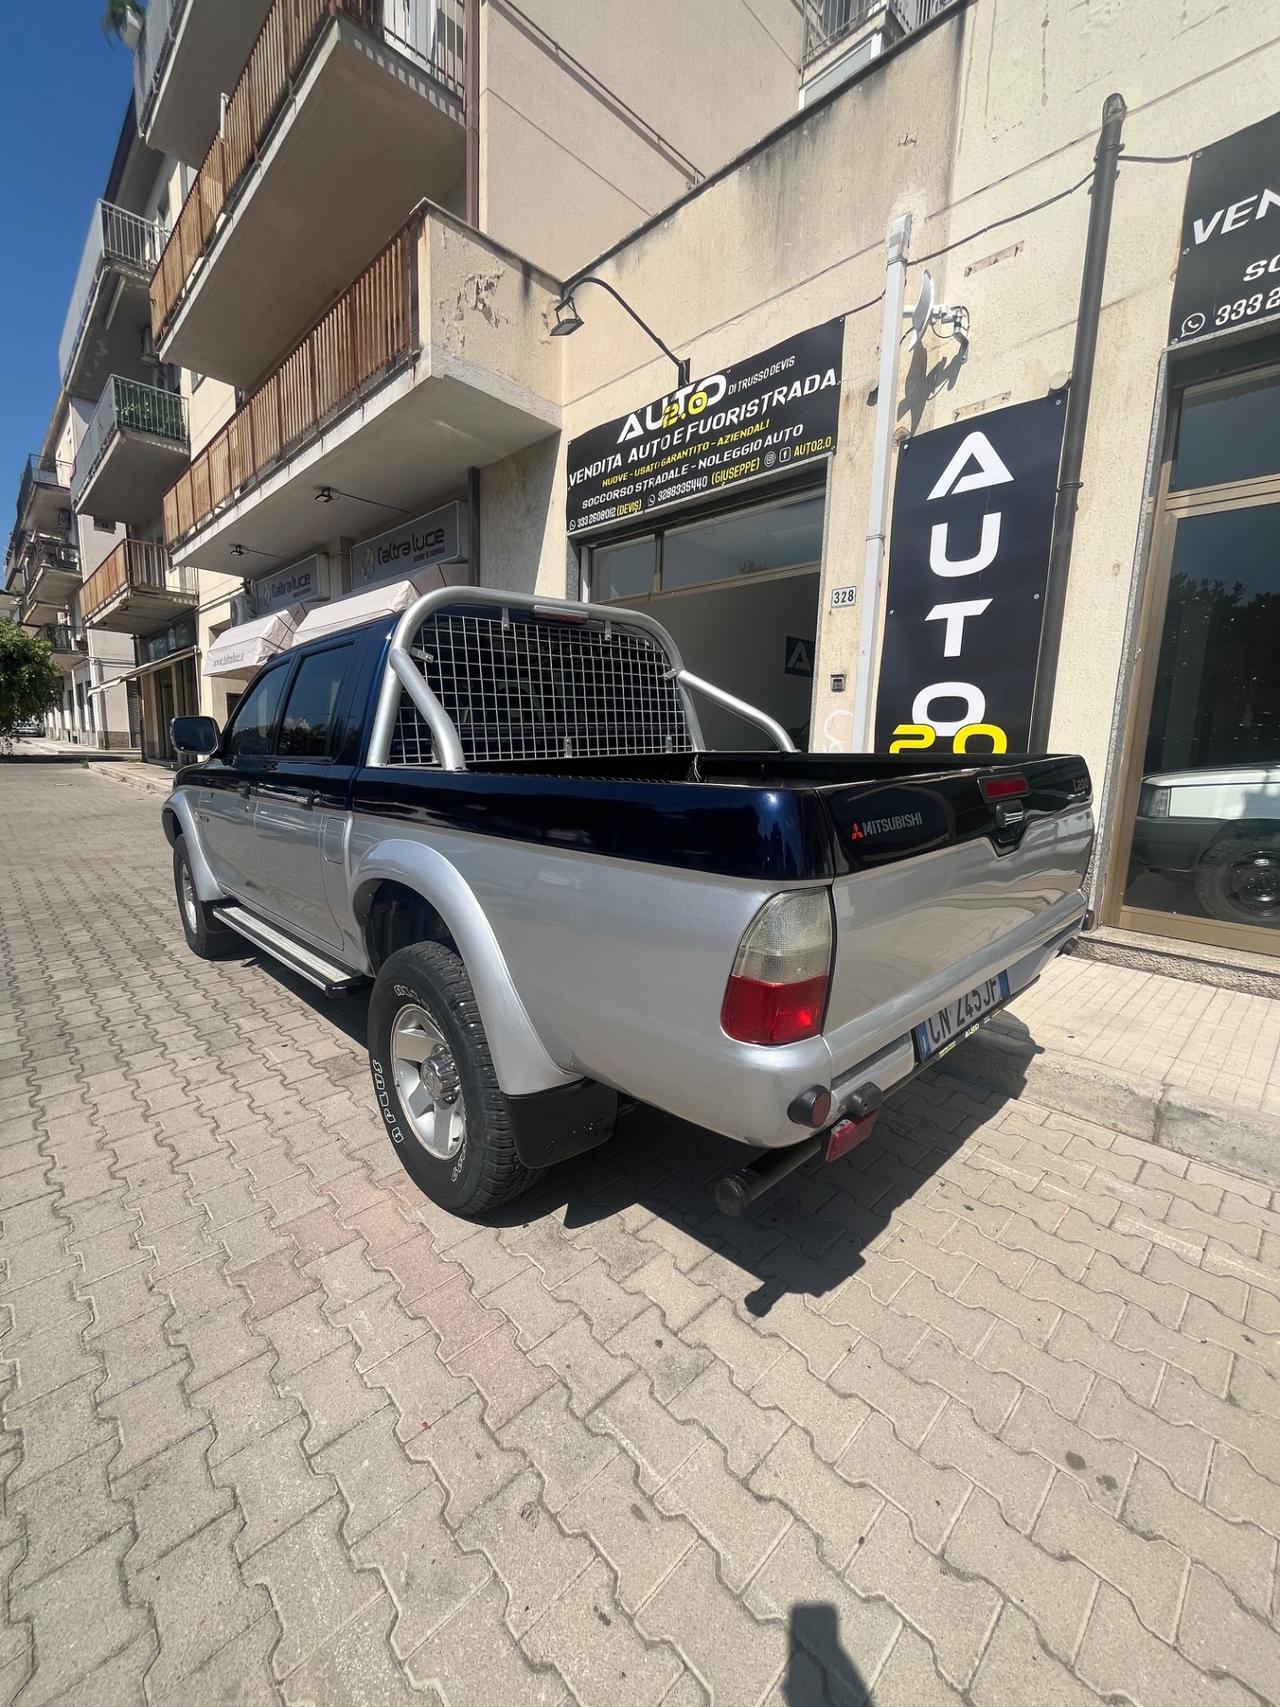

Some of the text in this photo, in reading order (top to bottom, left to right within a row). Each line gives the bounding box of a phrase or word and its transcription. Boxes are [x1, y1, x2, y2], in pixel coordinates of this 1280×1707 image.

[1215, 293, 1263, 326] 333
[728, 355, 795, 395] DI TRUSSO DEVIS
[569, 367, 837, 487] VENDITA AUTO E FUORISTRADA
[616, 374, 727, 445] AUTO
[662, 390, 709, 429] 2.0
[582, 485, 634, 509] SOCCORSO
[635, 463, 690, 492] STRADALE
[698, 439, 762, 470] NOLEGGIO
[763, 423, 804, 448] AUTO
[601, 472, 629, 488] NUOVE
[634, 460, 660, 477] USATO
[660, 441, 709, 467] GARANTITO
[716, 418, 770, 446] AZIENDALI
[577, 515, 589, 528] 333
[711, 457, 760, 485] (GIUSEPPE)
[793, 436, 832, 457] AUTO2.0
[833, 589, 854, 604] 328
[861, 811, 923, 836] MITSUBISHI
